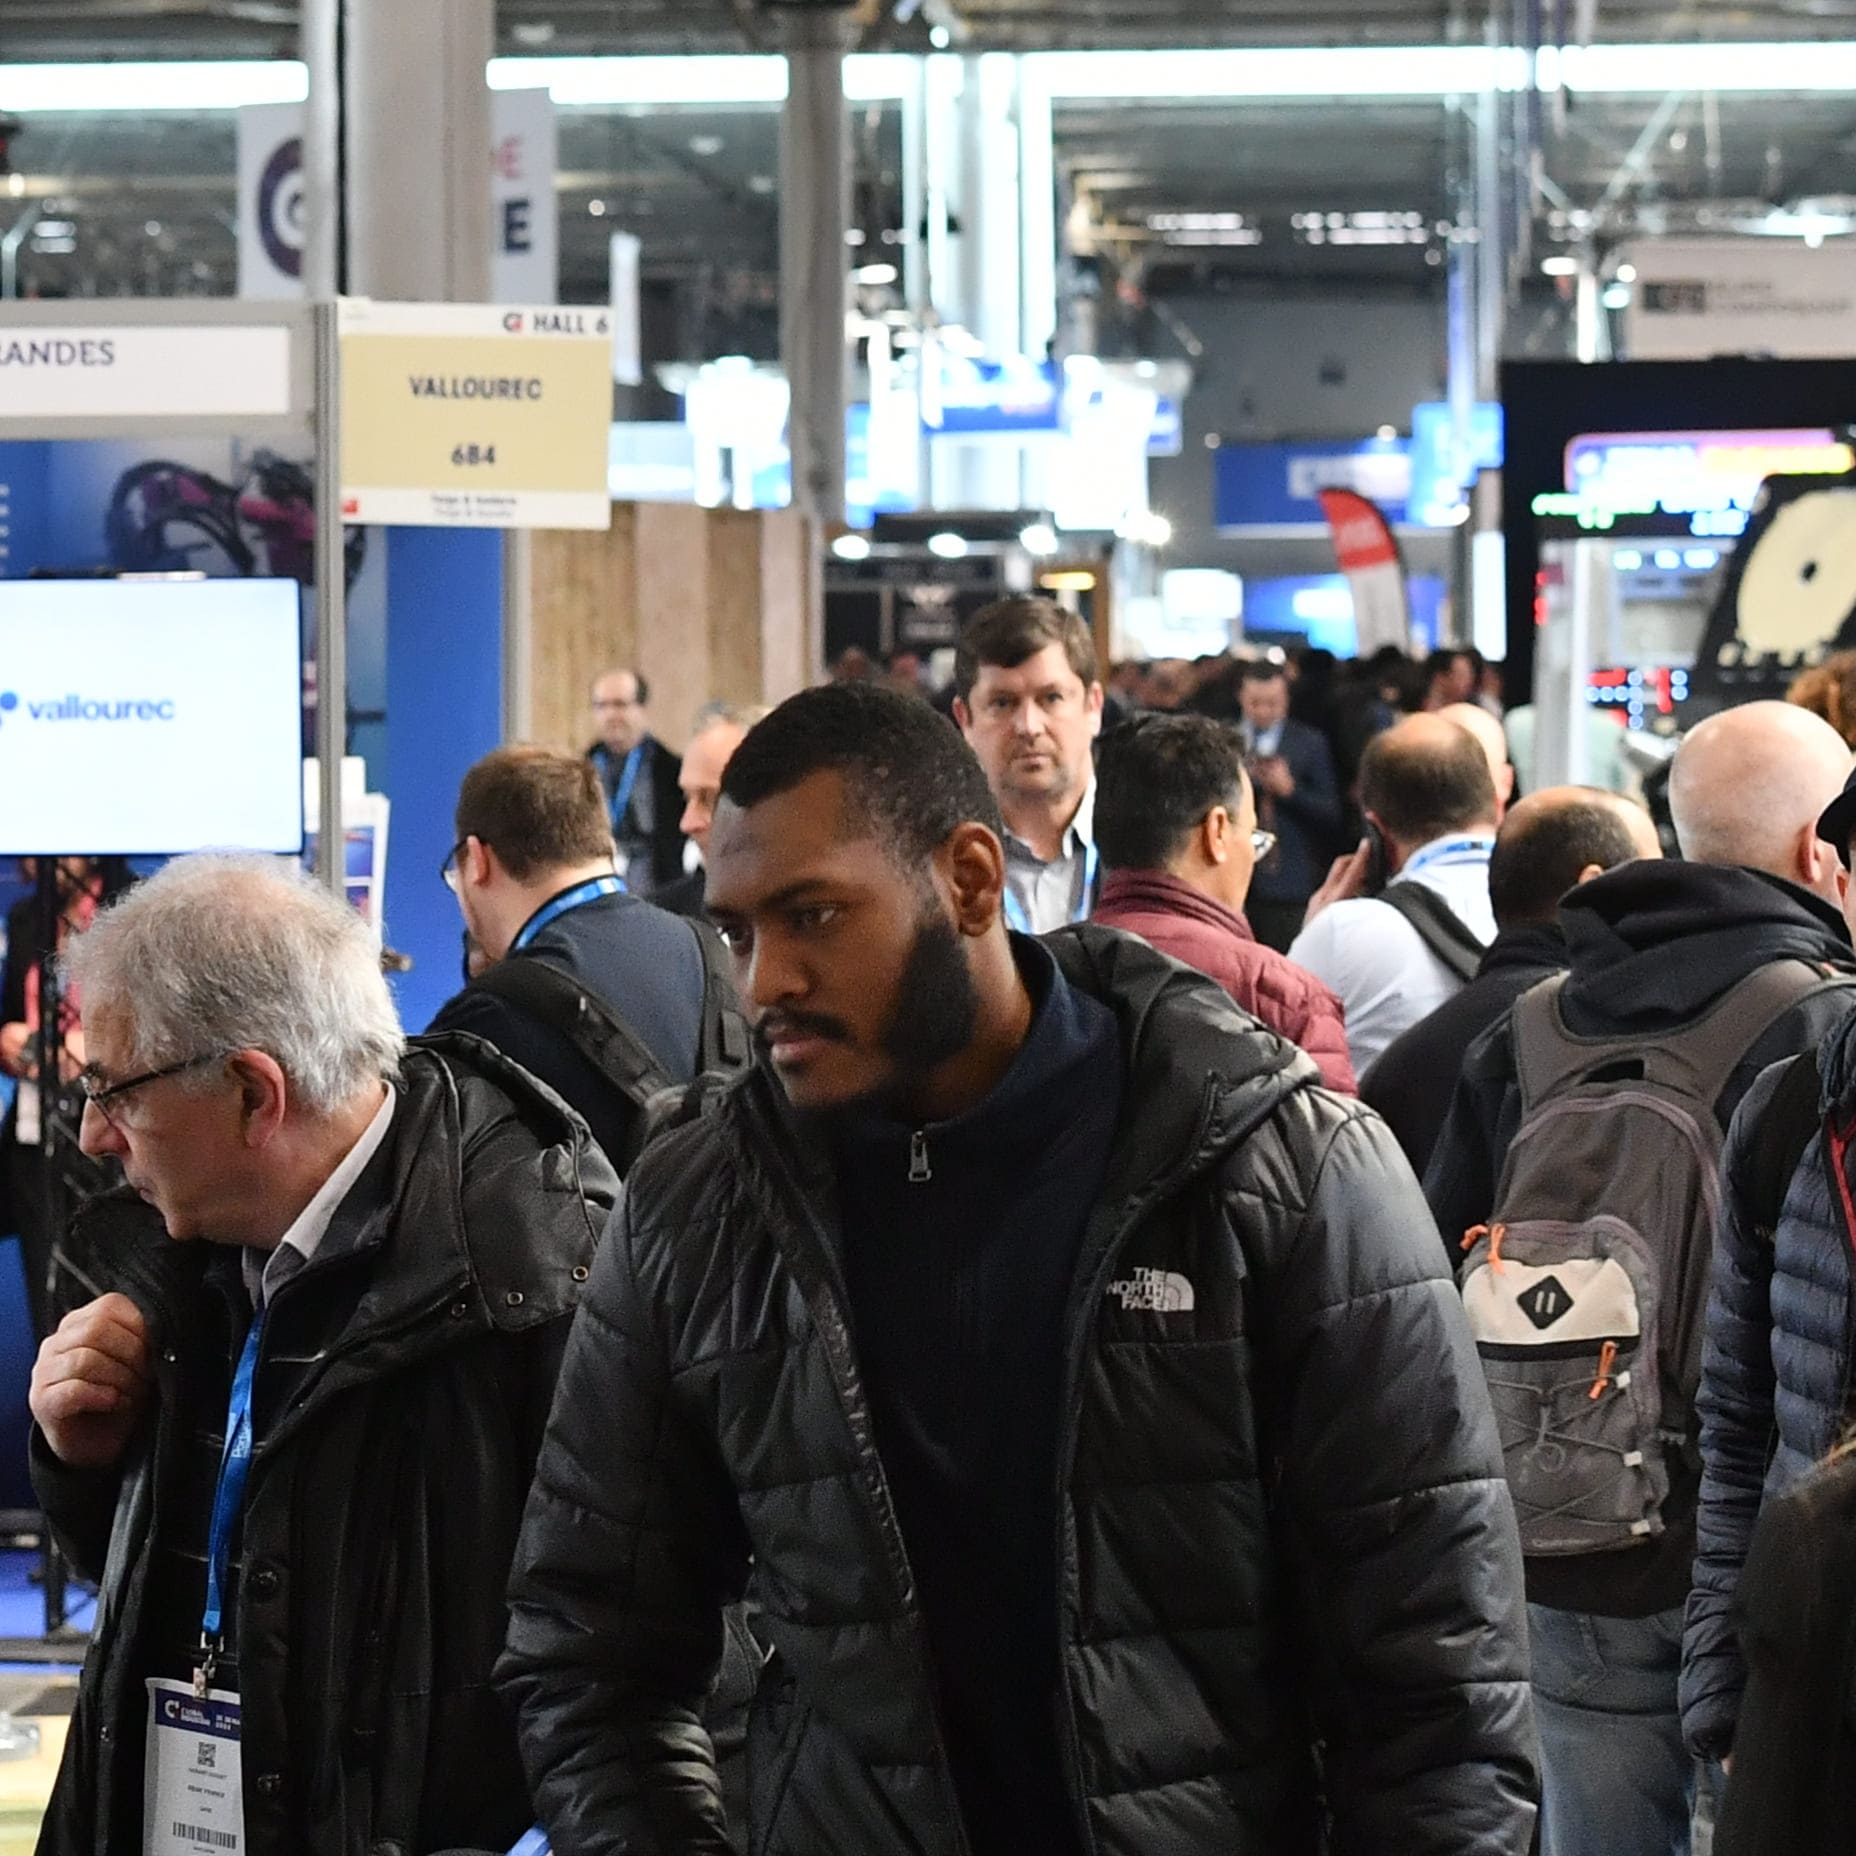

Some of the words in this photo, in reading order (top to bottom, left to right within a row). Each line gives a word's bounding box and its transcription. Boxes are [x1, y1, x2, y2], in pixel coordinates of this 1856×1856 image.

[532, 314, 587, 335] HALL
[595, 314, 610, 335] 6
[408, 374, 543, 402] VALLOUREC
[27, 693, 176, 722] vallourec
[1133, 1267, 1166, 1283] THE
[1106, 1280, 1164, 1296] NORTH
[1121, 1294, 1164, 1311] FACE
